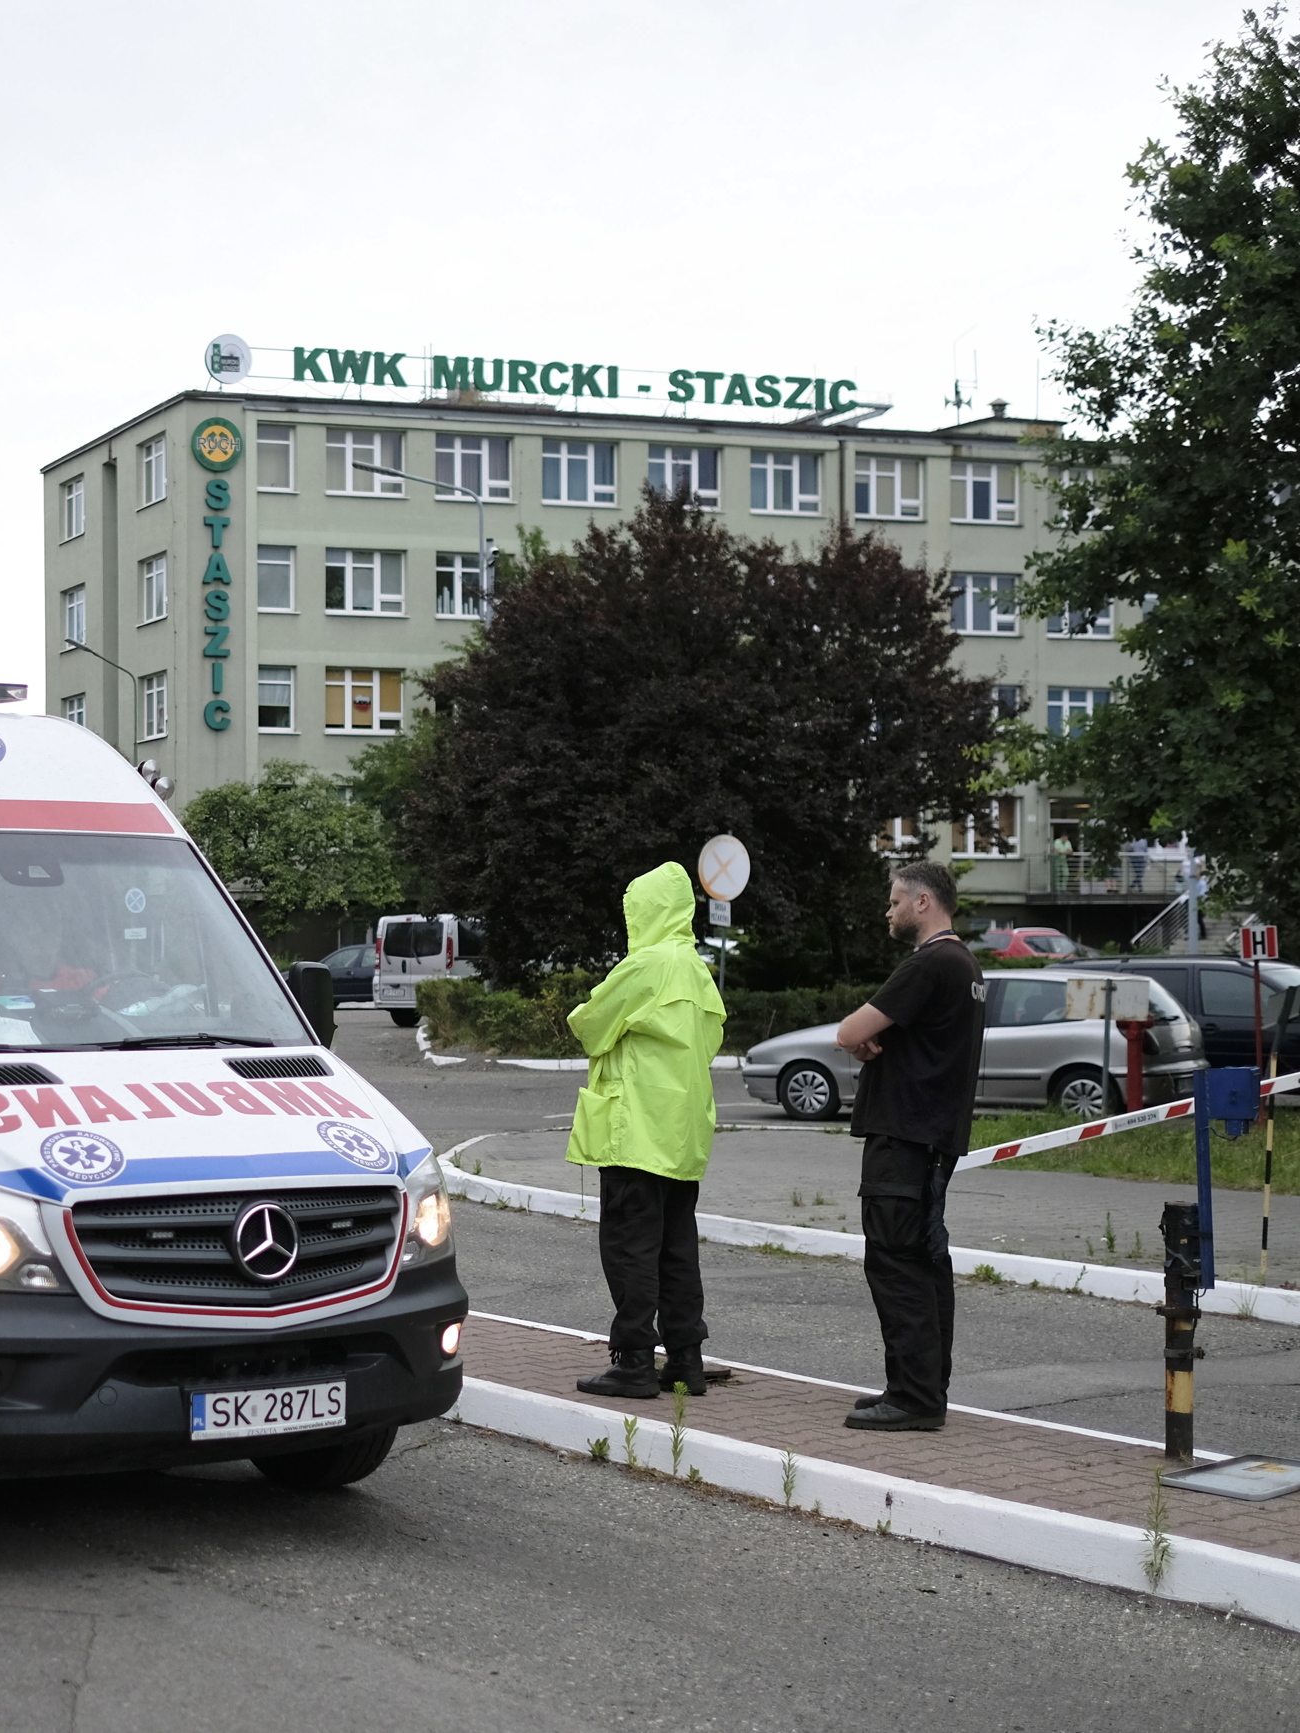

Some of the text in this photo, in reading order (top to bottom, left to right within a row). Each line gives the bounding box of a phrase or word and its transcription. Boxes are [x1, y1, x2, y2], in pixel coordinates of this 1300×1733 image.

[294, 346, 859, 413] KWK MURCKI - STASZIC
[196, 436, 241, 451] RUCH
[202, 479, 232, 731] STASZIC
[1252, 930, 1266, 955] H
[76, 1131, 121, 1162] RATOWNICTWO
[66, 1166, 116, 1180] MEDYCZNE
[193, 1386, 342, 1427] PL SK 287LS
